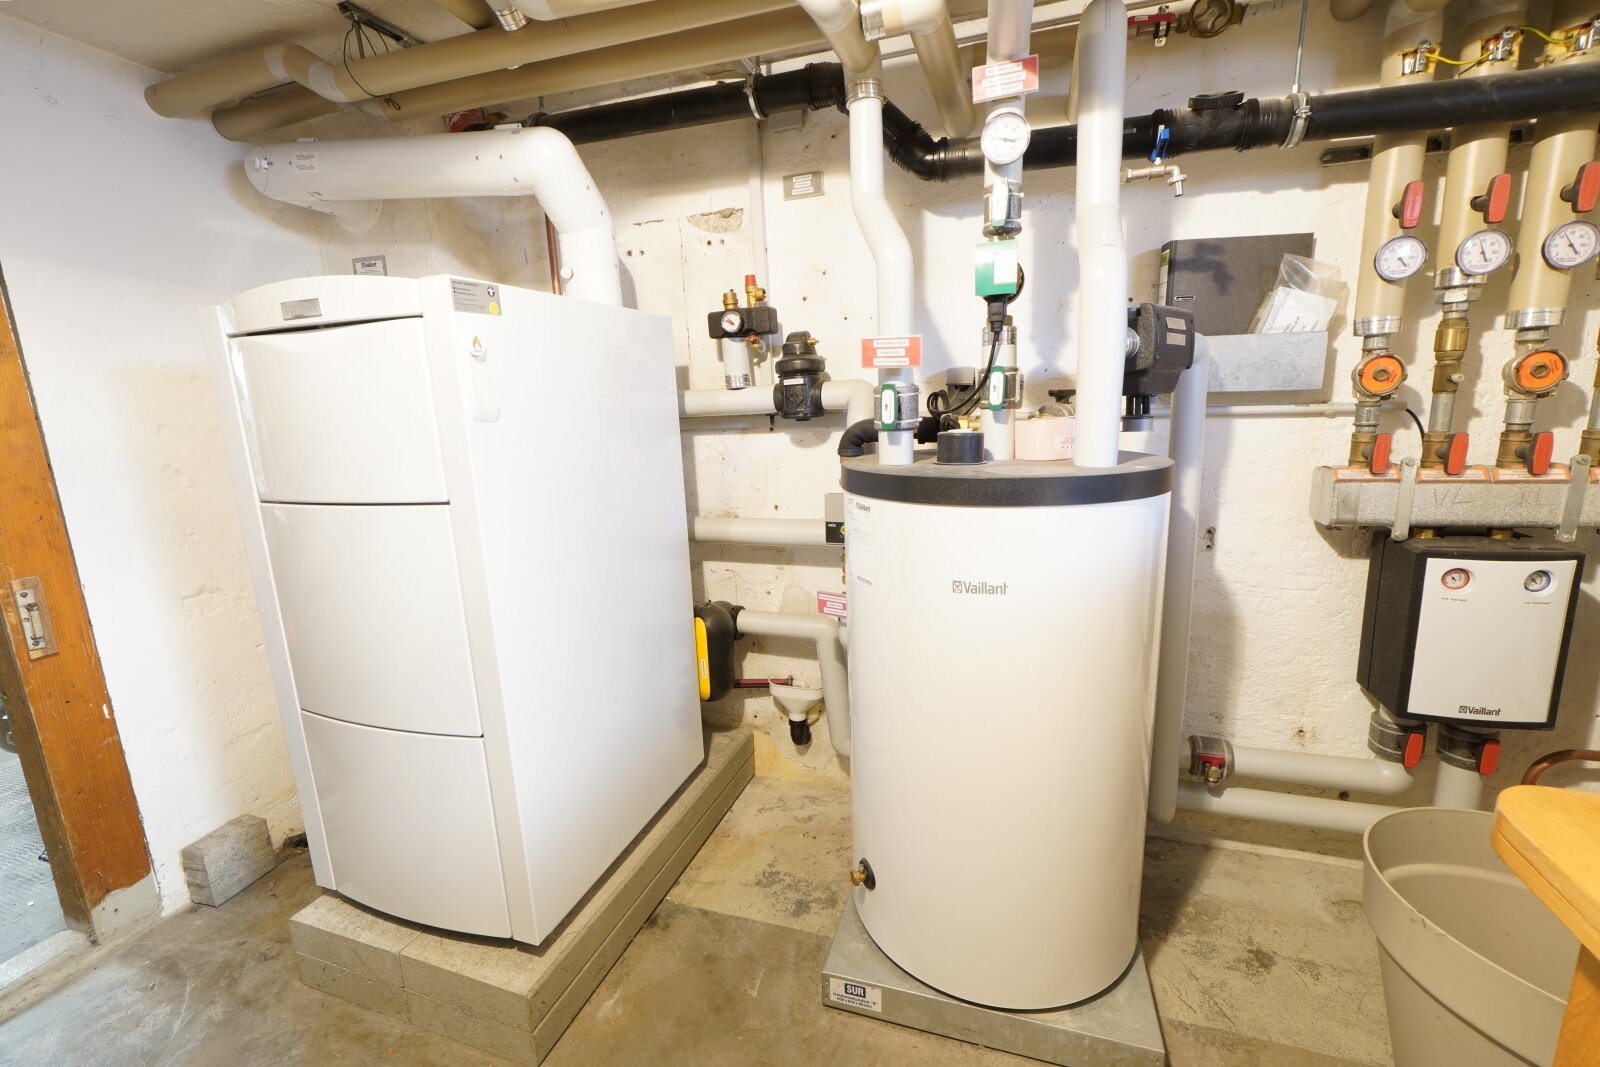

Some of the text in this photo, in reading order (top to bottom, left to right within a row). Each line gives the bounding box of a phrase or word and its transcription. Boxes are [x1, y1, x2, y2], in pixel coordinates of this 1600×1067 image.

[963, 581, 1008, 595] Vaillant
[1468, 706, 1501, 717] Vaillant
[846, 984, 864, 997] SUR
